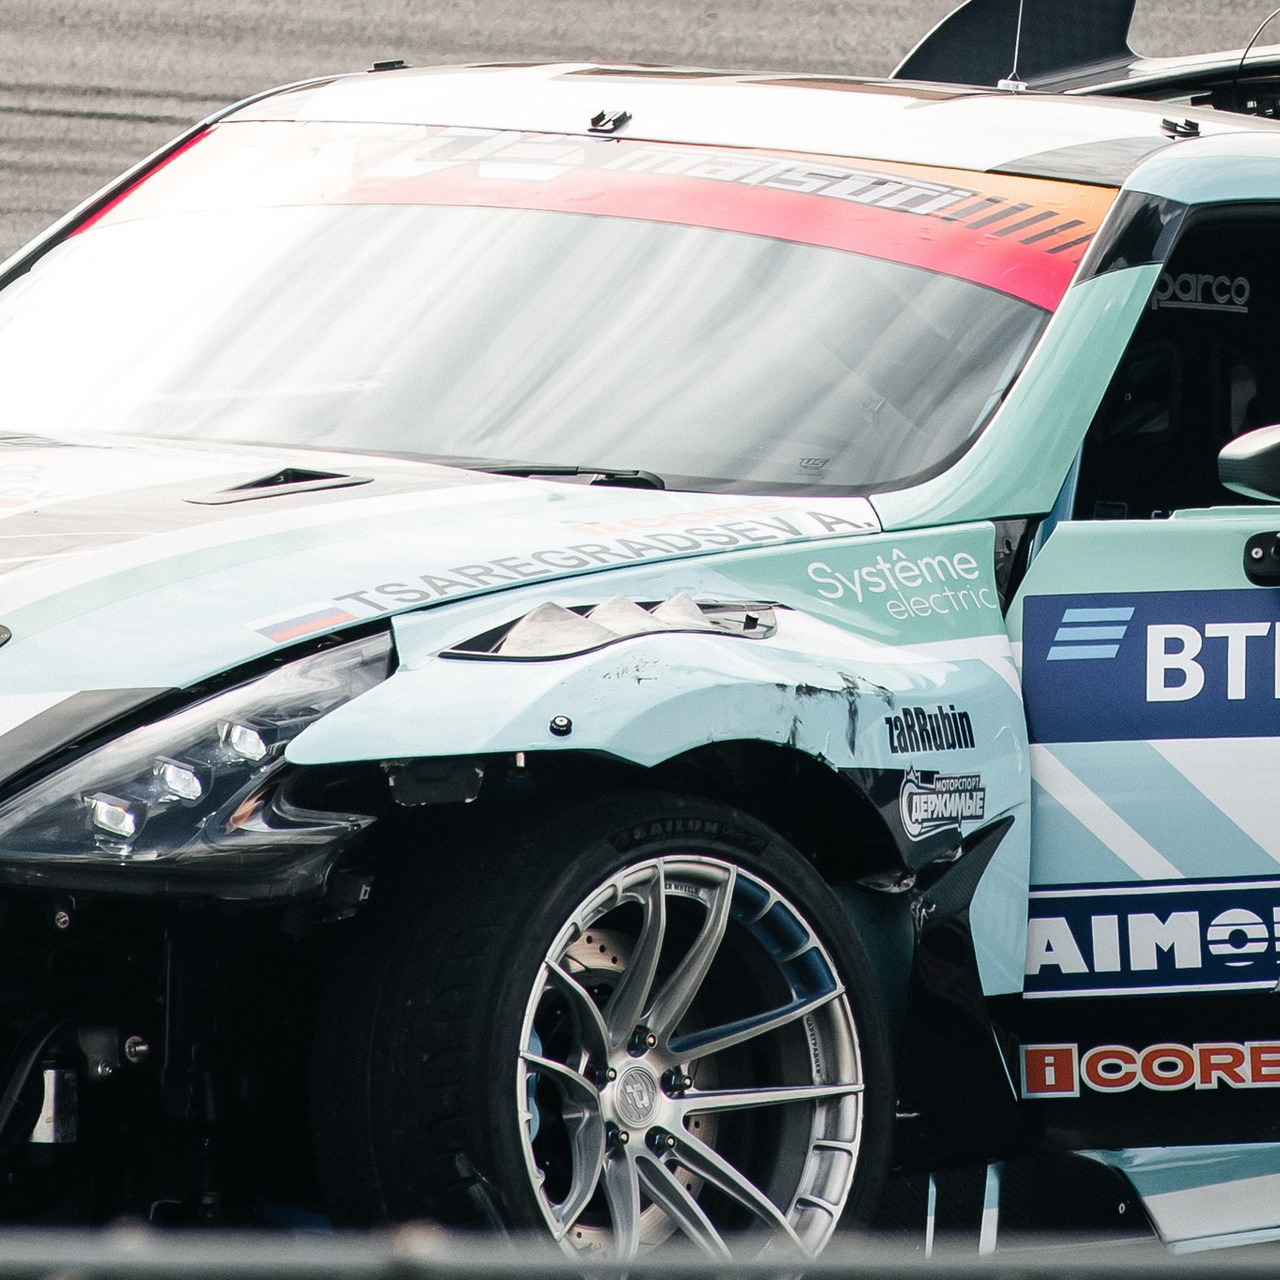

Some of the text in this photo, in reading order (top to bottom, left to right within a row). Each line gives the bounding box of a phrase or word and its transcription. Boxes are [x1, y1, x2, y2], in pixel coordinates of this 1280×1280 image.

[334, 510, 875, 613] TSAREGRADSEV A.
[807, 548, 980, 603] Systême
[886, 585, 998, 620] electric
[885, 704, 976, 754] zaRRubin
[935, 776, 980, 791] МОТОРСПОРТ
